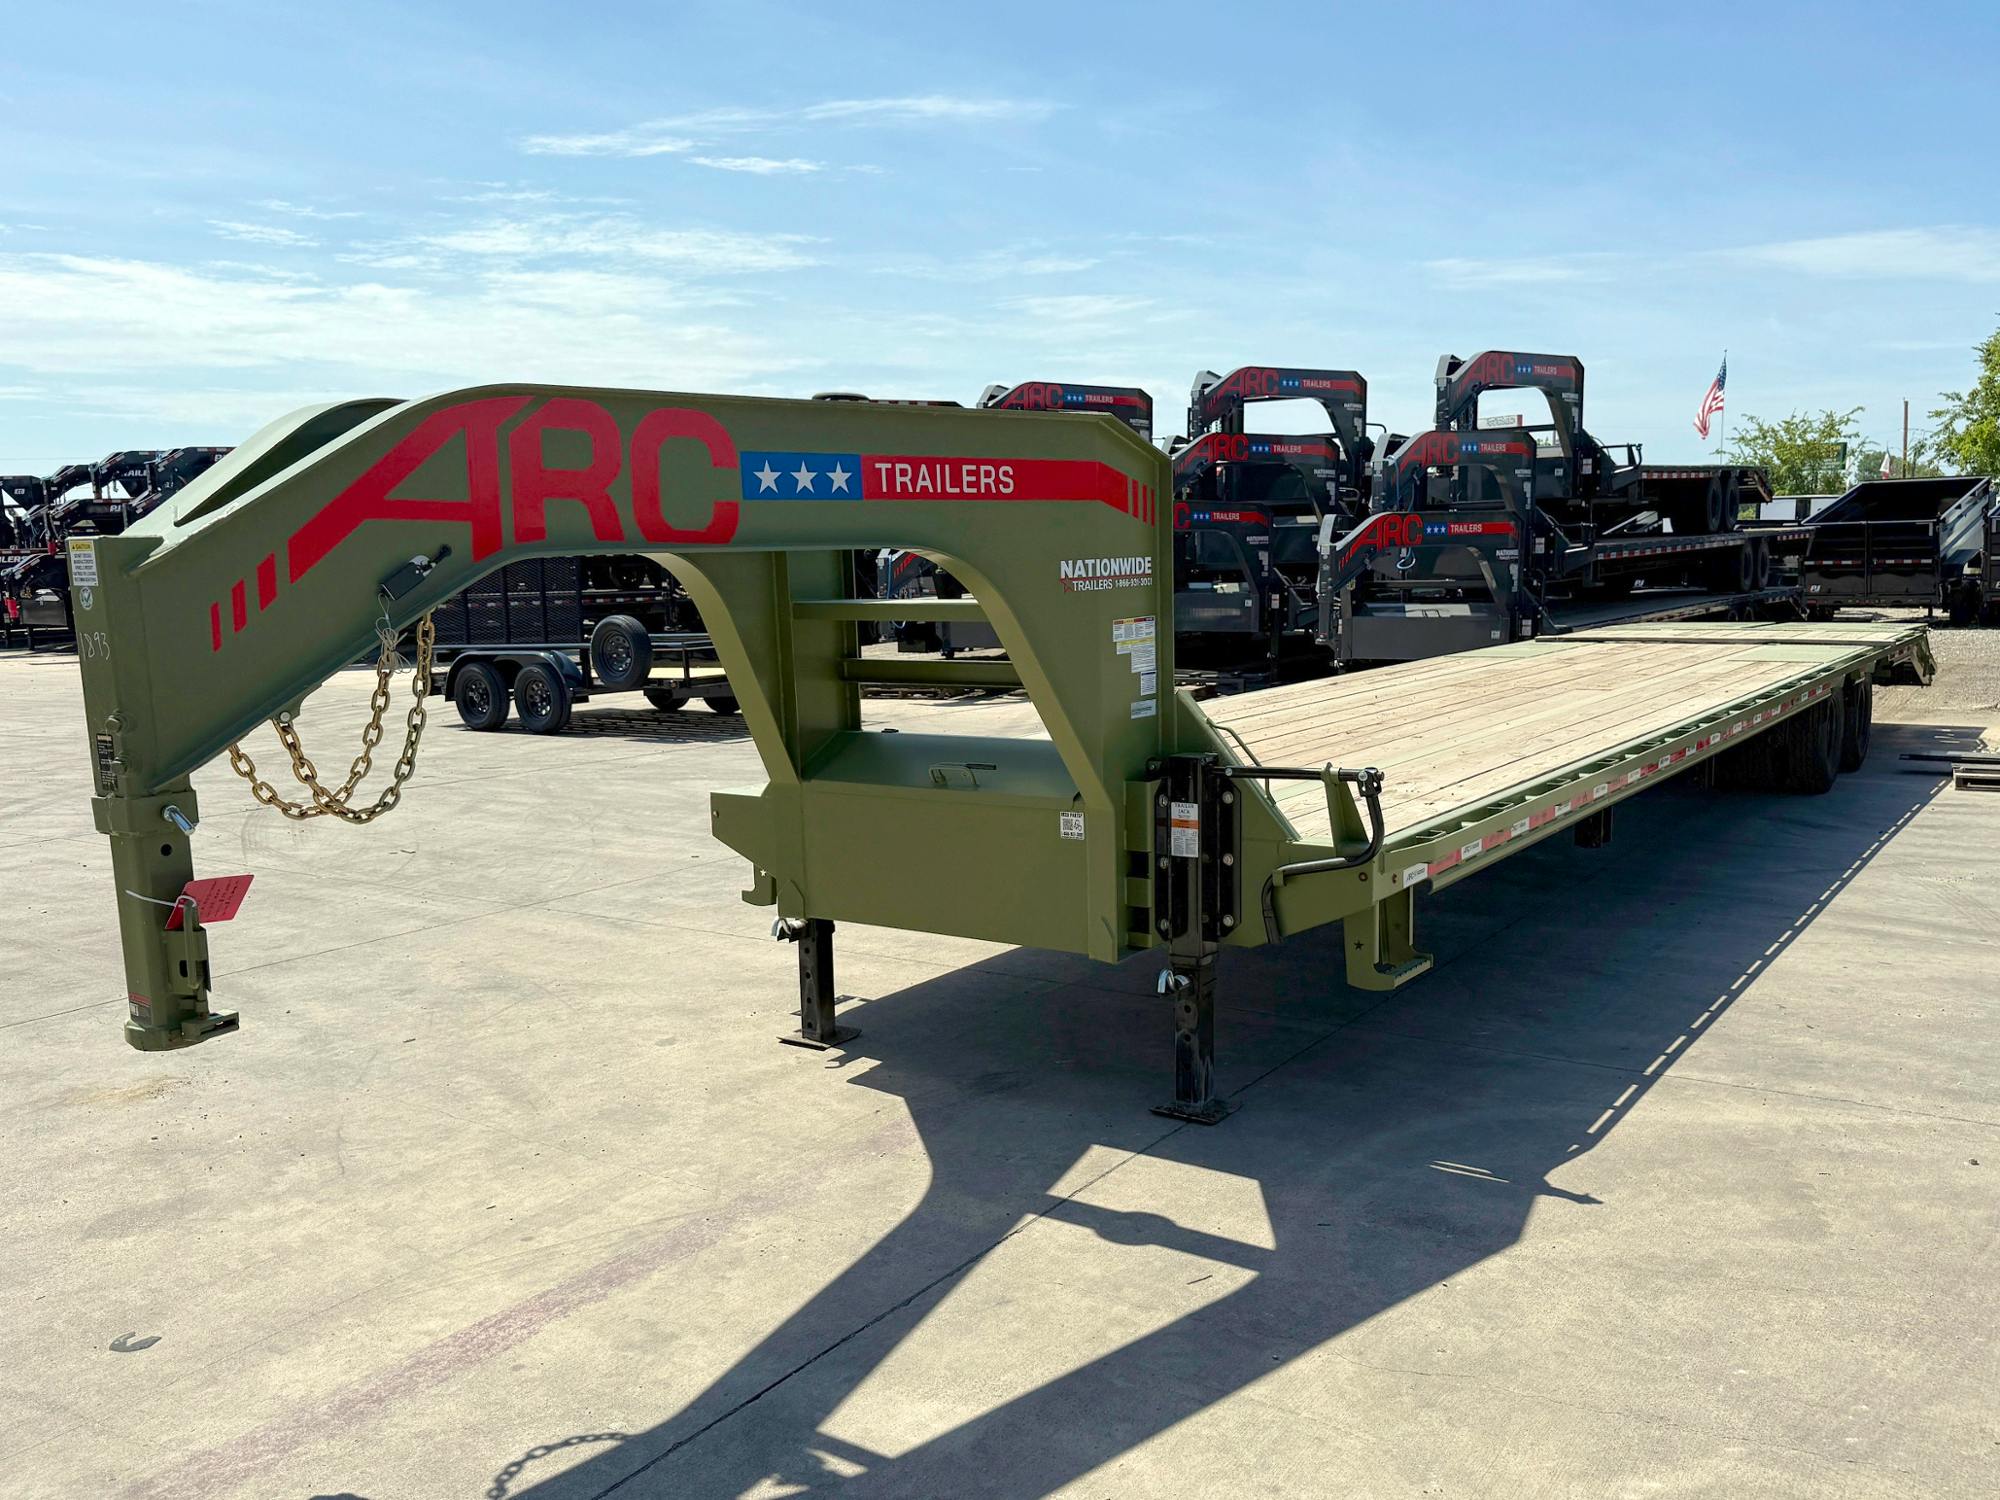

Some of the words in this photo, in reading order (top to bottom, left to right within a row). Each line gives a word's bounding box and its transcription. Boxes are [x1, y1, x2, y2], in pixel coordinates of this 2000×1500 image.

[1217, 367, 1280, 400] ARC
[1302, 379, 1331, 389] TRAILERS
[1461, 351, 1515, 390] ARC
[1534, 365, 1558, 376] TRAILERS
[1001, 383, 1064, 412] ARC
[1085, 394, 1114, 404] TRAILERS
[1184, 433, 1249, 464] ARC
[1273, 445, 1302, 454] TRAILERS
[1400, 432, 1460, 474] ARC
[1480, 443, 1506, 453] TRAILERS
[287, 395, 740, 584] ARC
[874, 462, 1015, 494] TRAILERS
[1213, 512, 1240, 521] TRAILERS
[1349, 513, 1423, 553] ARC
[1450, 523, 1483, 534] TRAILERS
[1060, 556, 1152, 579] NATIONWIDE
[1073, 579, 1113, 592] TRAILERS
